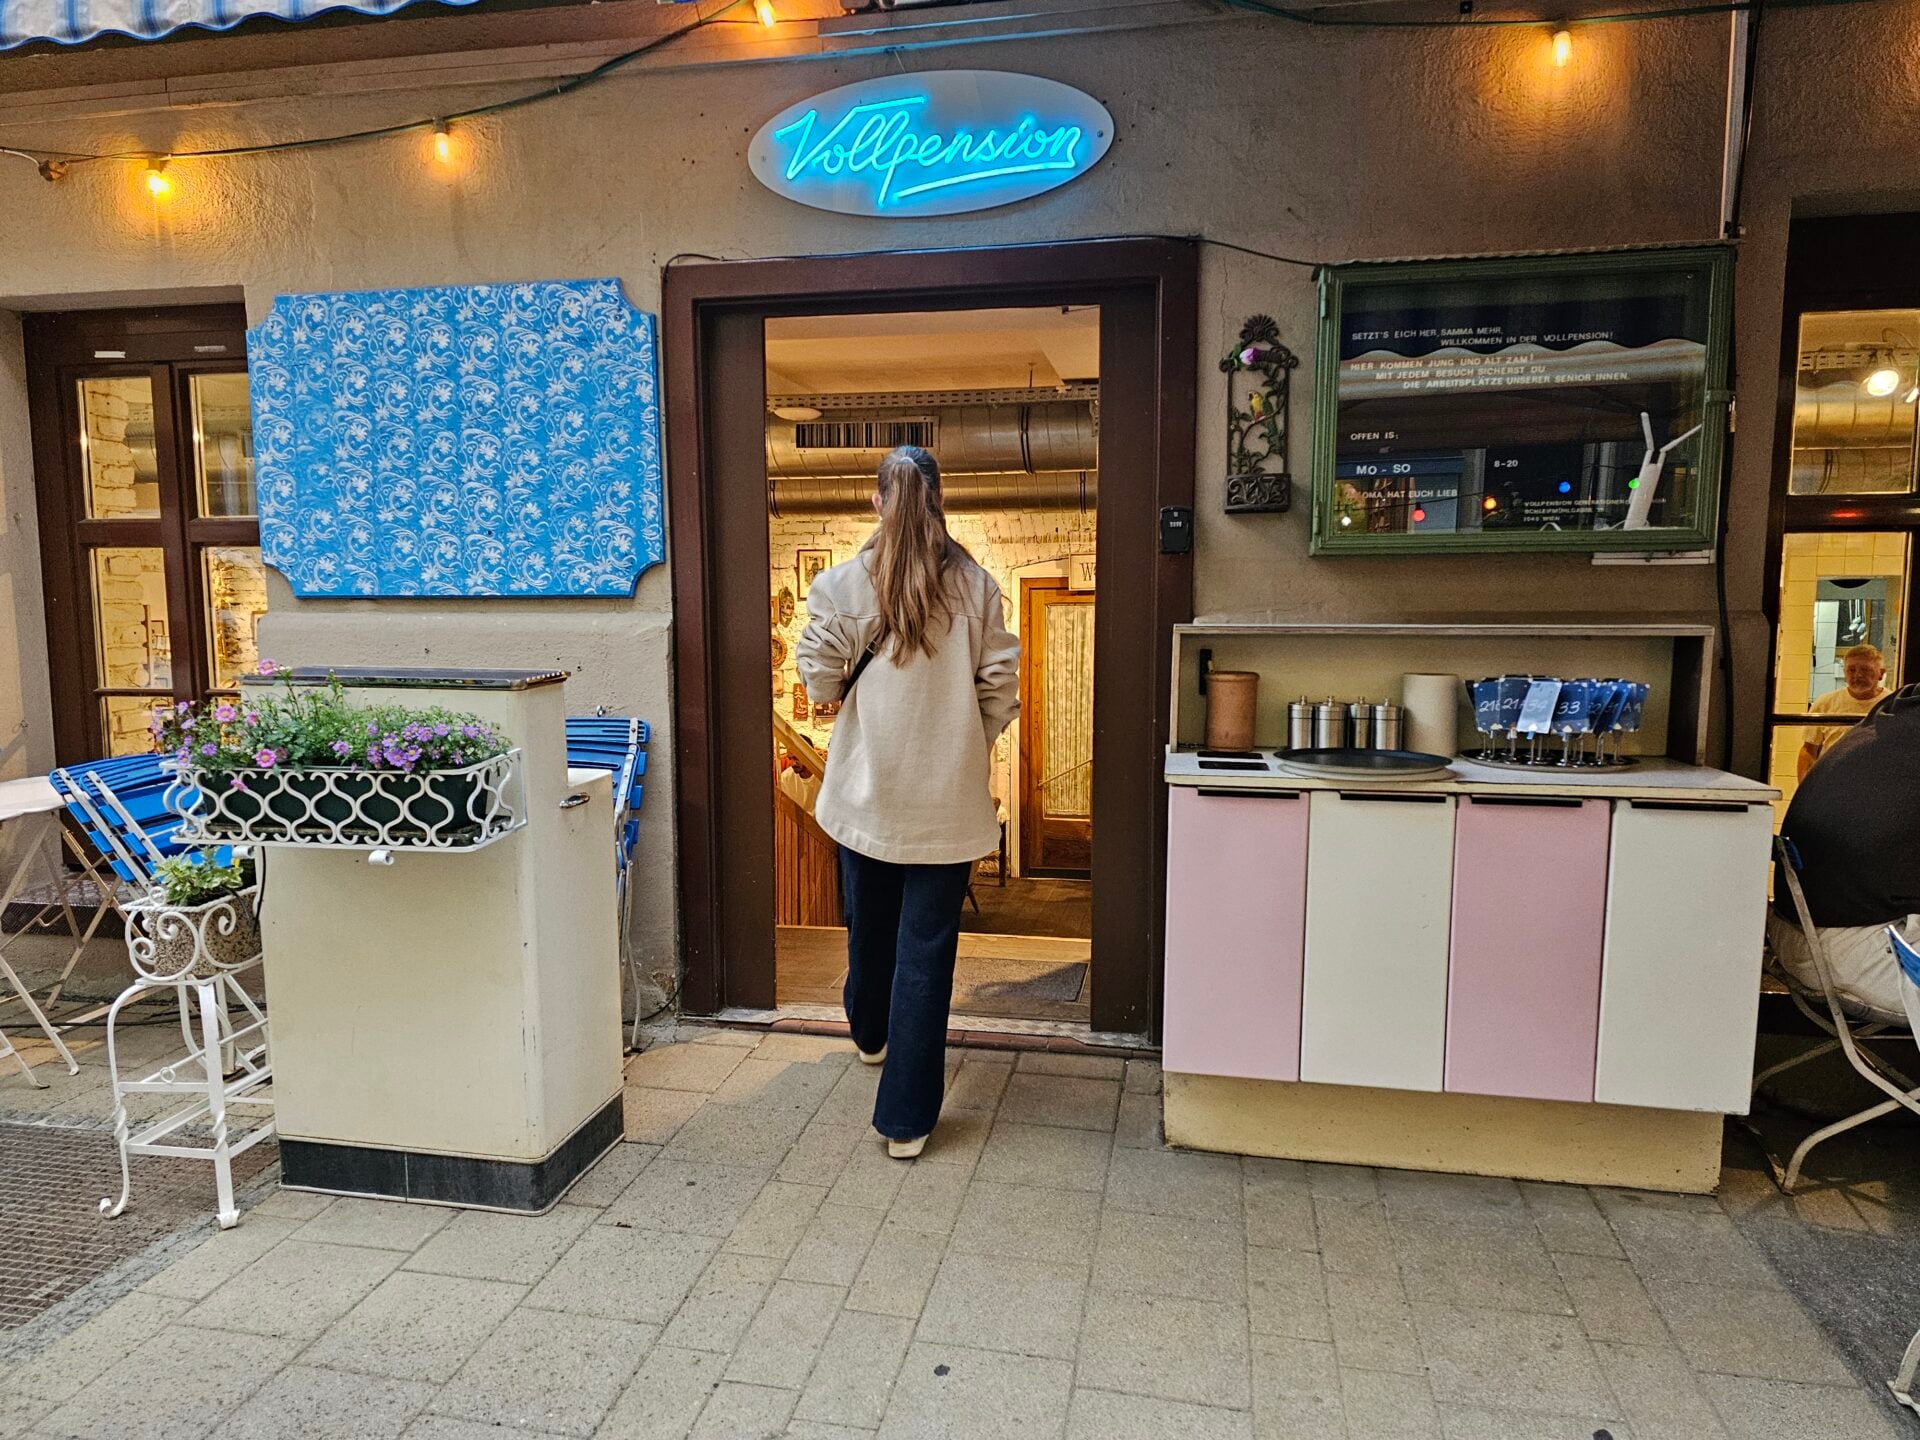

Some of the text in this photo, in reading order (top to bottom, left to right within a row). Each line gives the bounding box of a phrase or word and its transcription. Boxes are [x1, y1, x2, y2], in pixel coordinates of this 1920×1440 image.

[774, 95, 1082, 208] Vollpension
[1352, 331, 1389, 340] SETZT'S
[1394, 329, 1416, 338] EICH
[1441, 327, 1473, 337] SAMMA
[1441, 337, 1502, 346] WILLKOMMEN
[1520, 335, 1537, 343] DER
[1543, 331, 1613, 342] VOLLPENSION!
[1350, 353, 1534, 371] HIER KOMMEN JUNG UND ALT ZAM!
[1396, 370, 1429, 379] JEDEM
[1436, 368, 1473, 377] BESUCH
[1478, 366, 1525, 376] SICHERST
[1531, 365, 1546, 373] DU
[1403, 381, 1420, 389] DIE
[1426, 375, 1503, 388] ARBEITSPLÄTZE
[1506, 375, 1550, 384] UNSERER
[1350, 432, 1380, 440] OFFEN
[1356, 465, 1377, 475] MO
[1393, 463, 1411, 474] SO
[1387, 490, 1405, 498] HAT
[1409, 489, 1434, 498] EUCH
[1437, 489, 1458, 497] LIEB
[1556, 700, 1581, 715] 33
